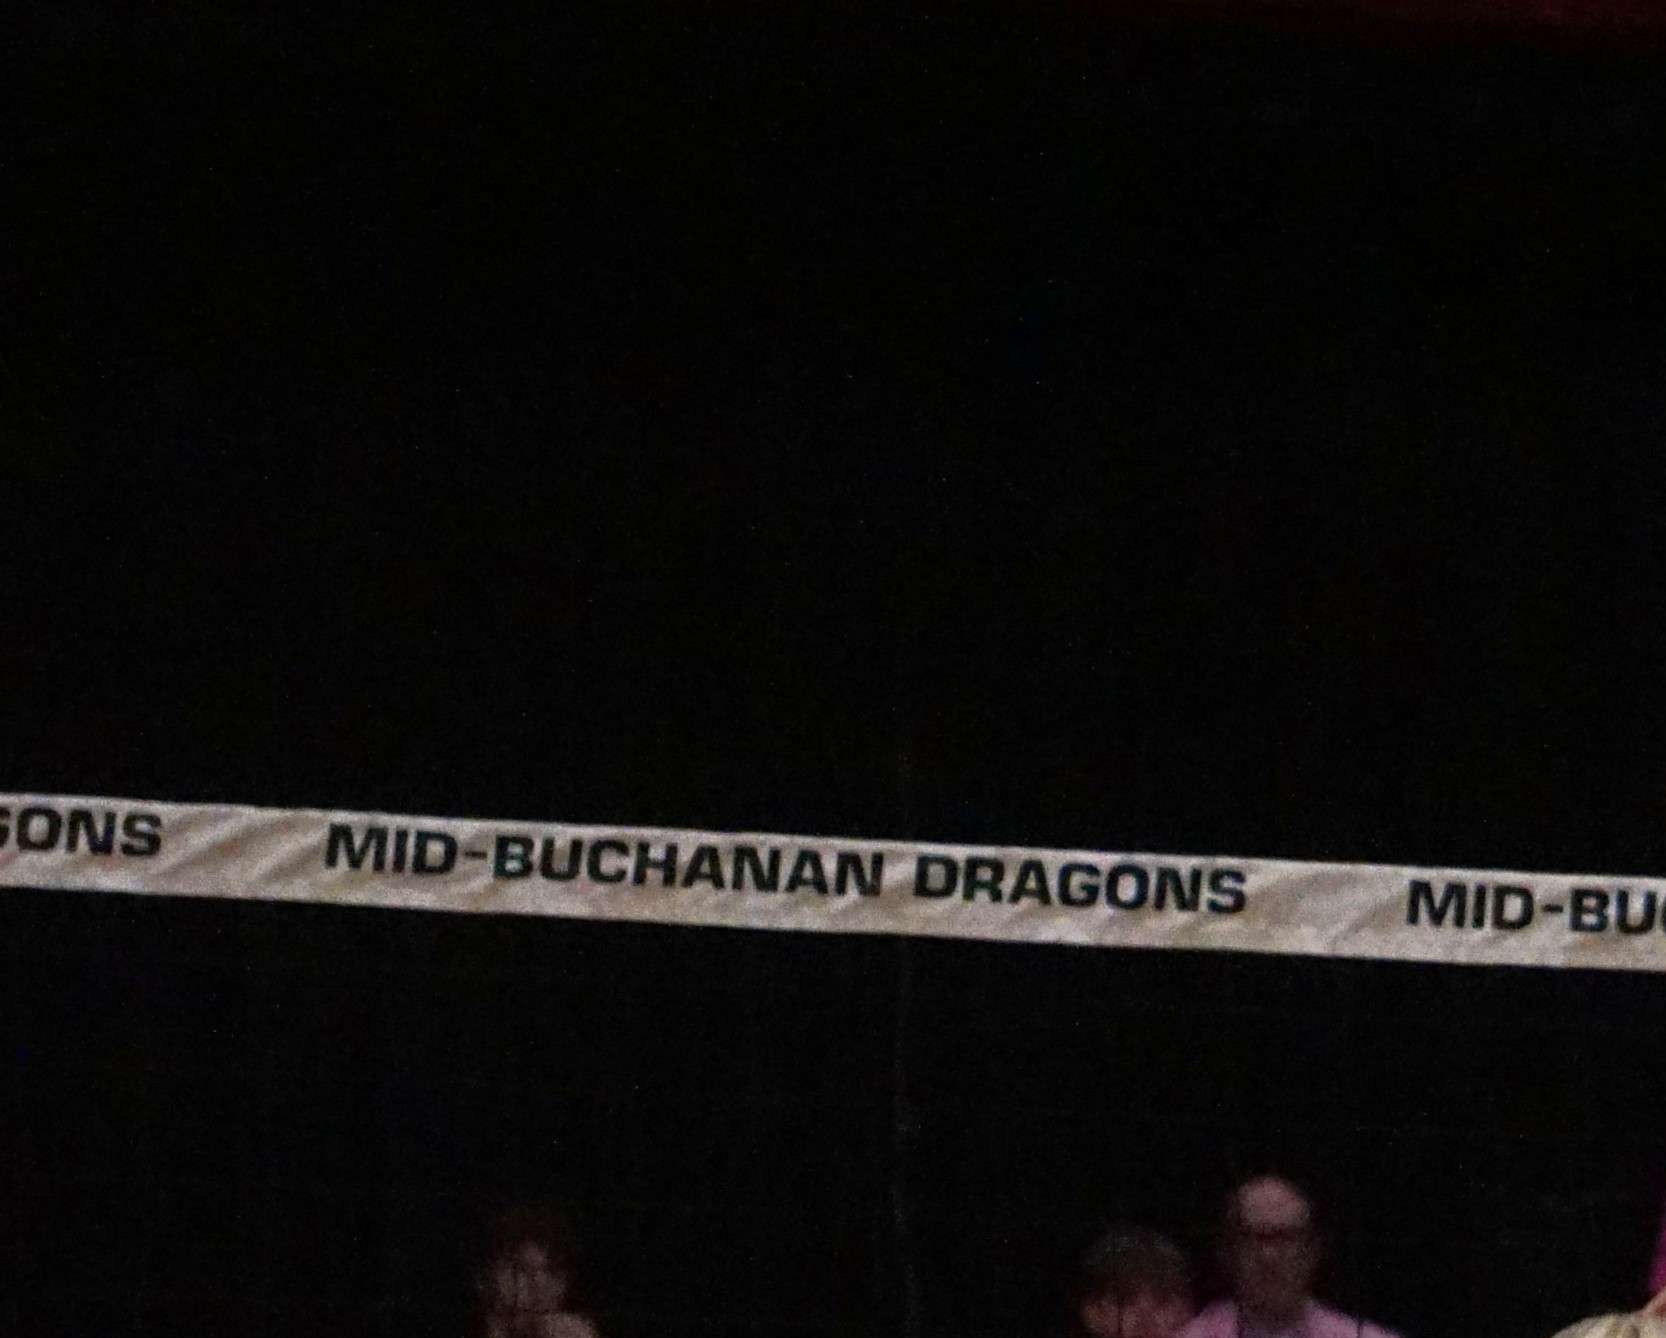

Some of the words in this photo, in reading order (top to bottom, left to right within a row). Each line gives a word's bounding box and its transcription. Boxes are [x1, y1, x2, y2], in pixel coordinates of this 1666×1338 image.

[0, 806, 163, 859] ONS
[325, 822, 884, 898] MID-BUCHANAN
[914, 854, 1248, 915] DRAGONS
